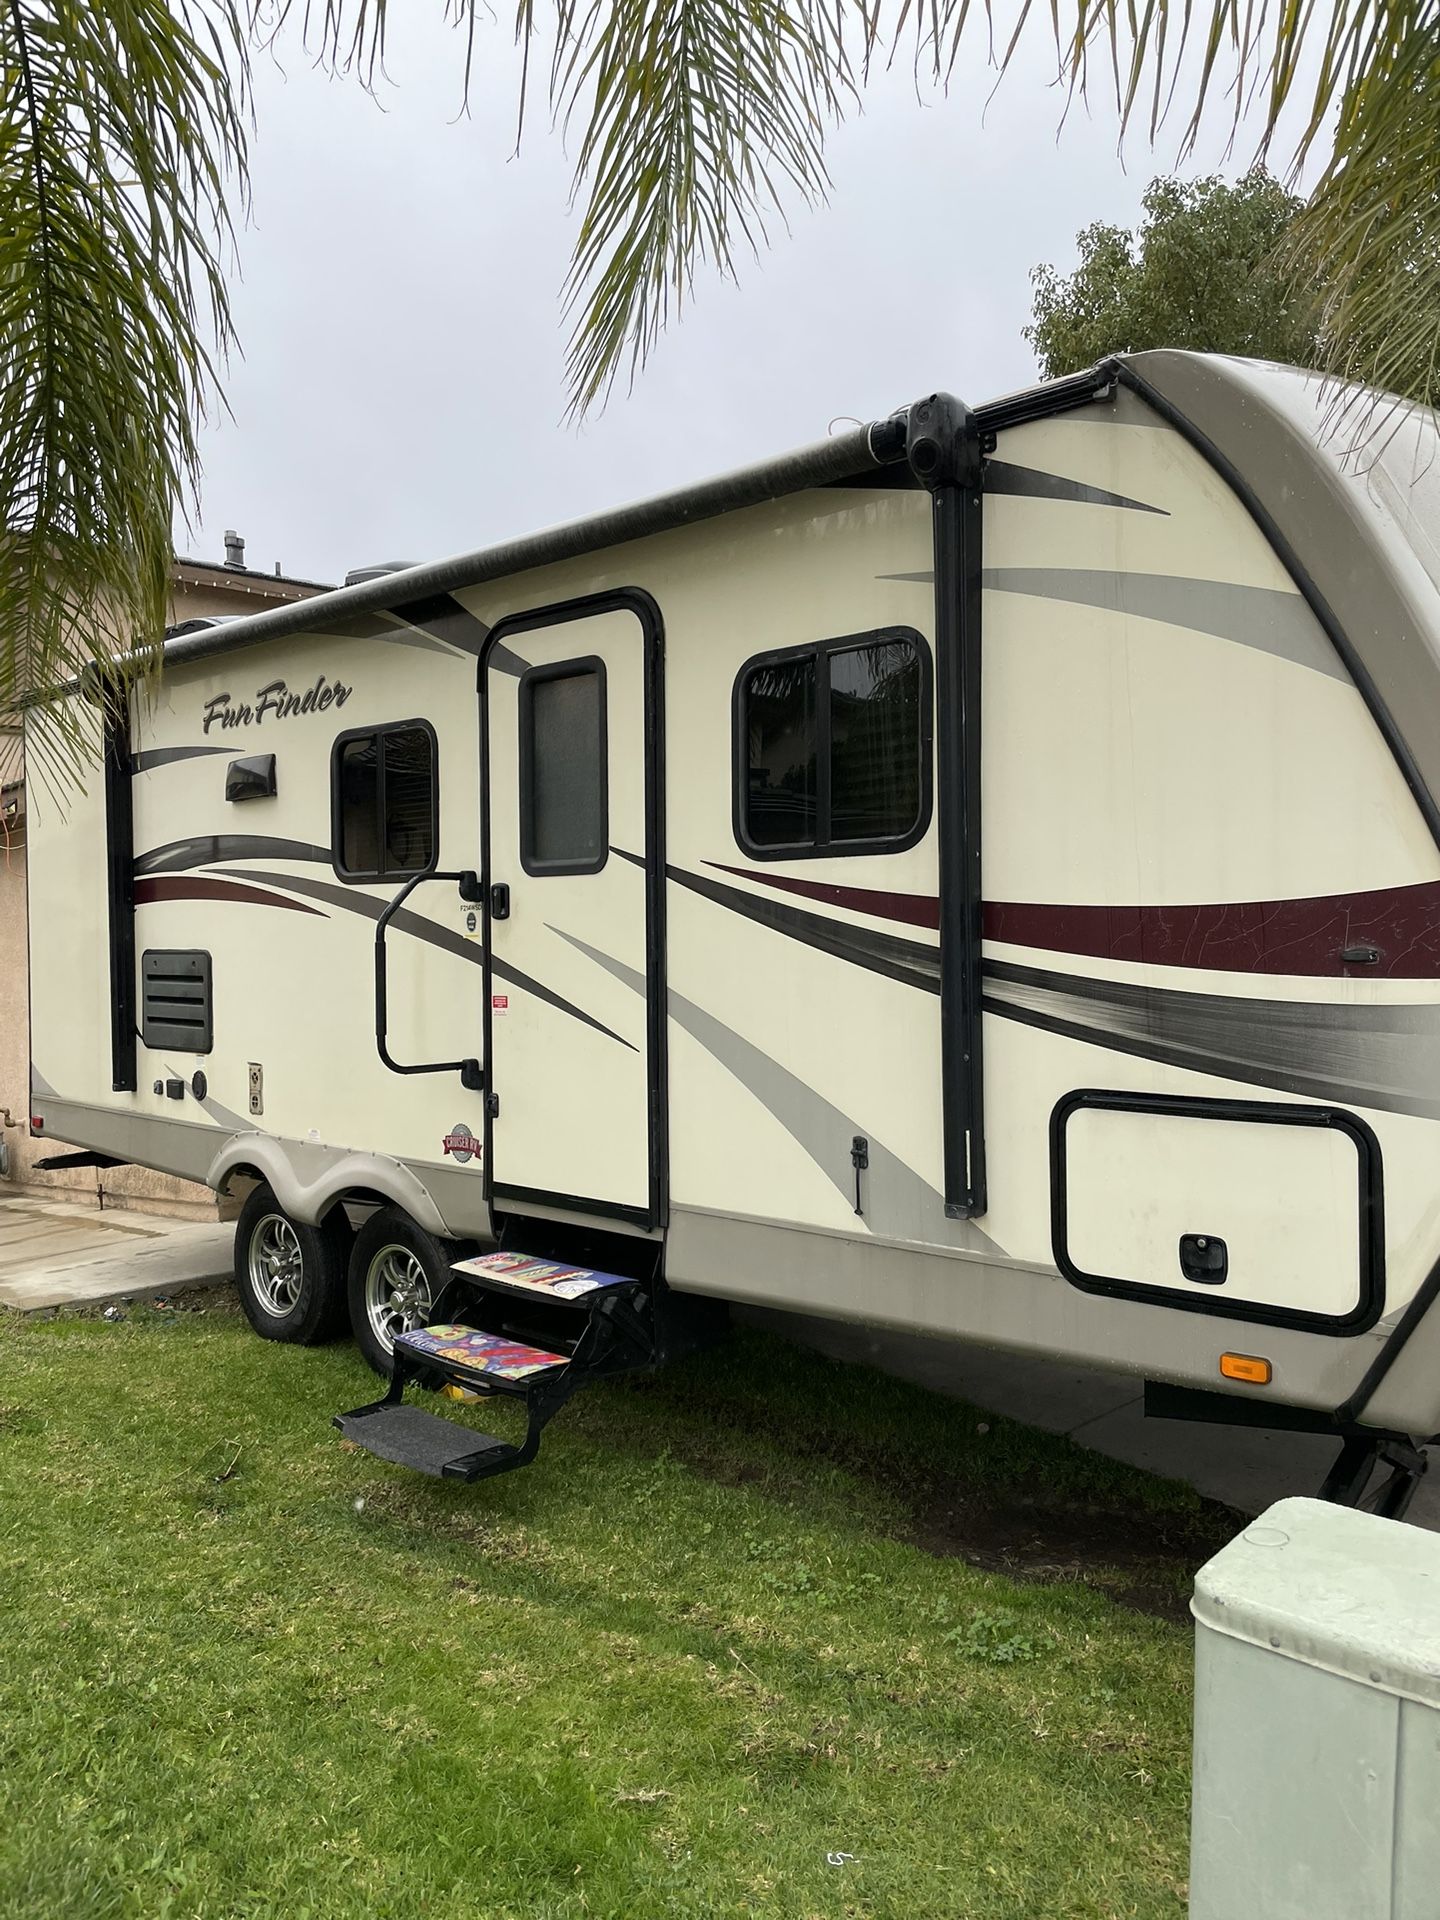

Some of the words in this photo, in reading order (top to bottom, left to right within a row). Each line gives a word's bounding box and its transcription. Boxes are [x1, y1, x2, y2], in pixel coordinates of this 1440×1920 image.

[203, 692, 254, 734] Fun
[255, 674, 353, 724] Finder
[446, 1136, 469, 1149] CRUISER
[469, 1139, 478, 1151] RV
